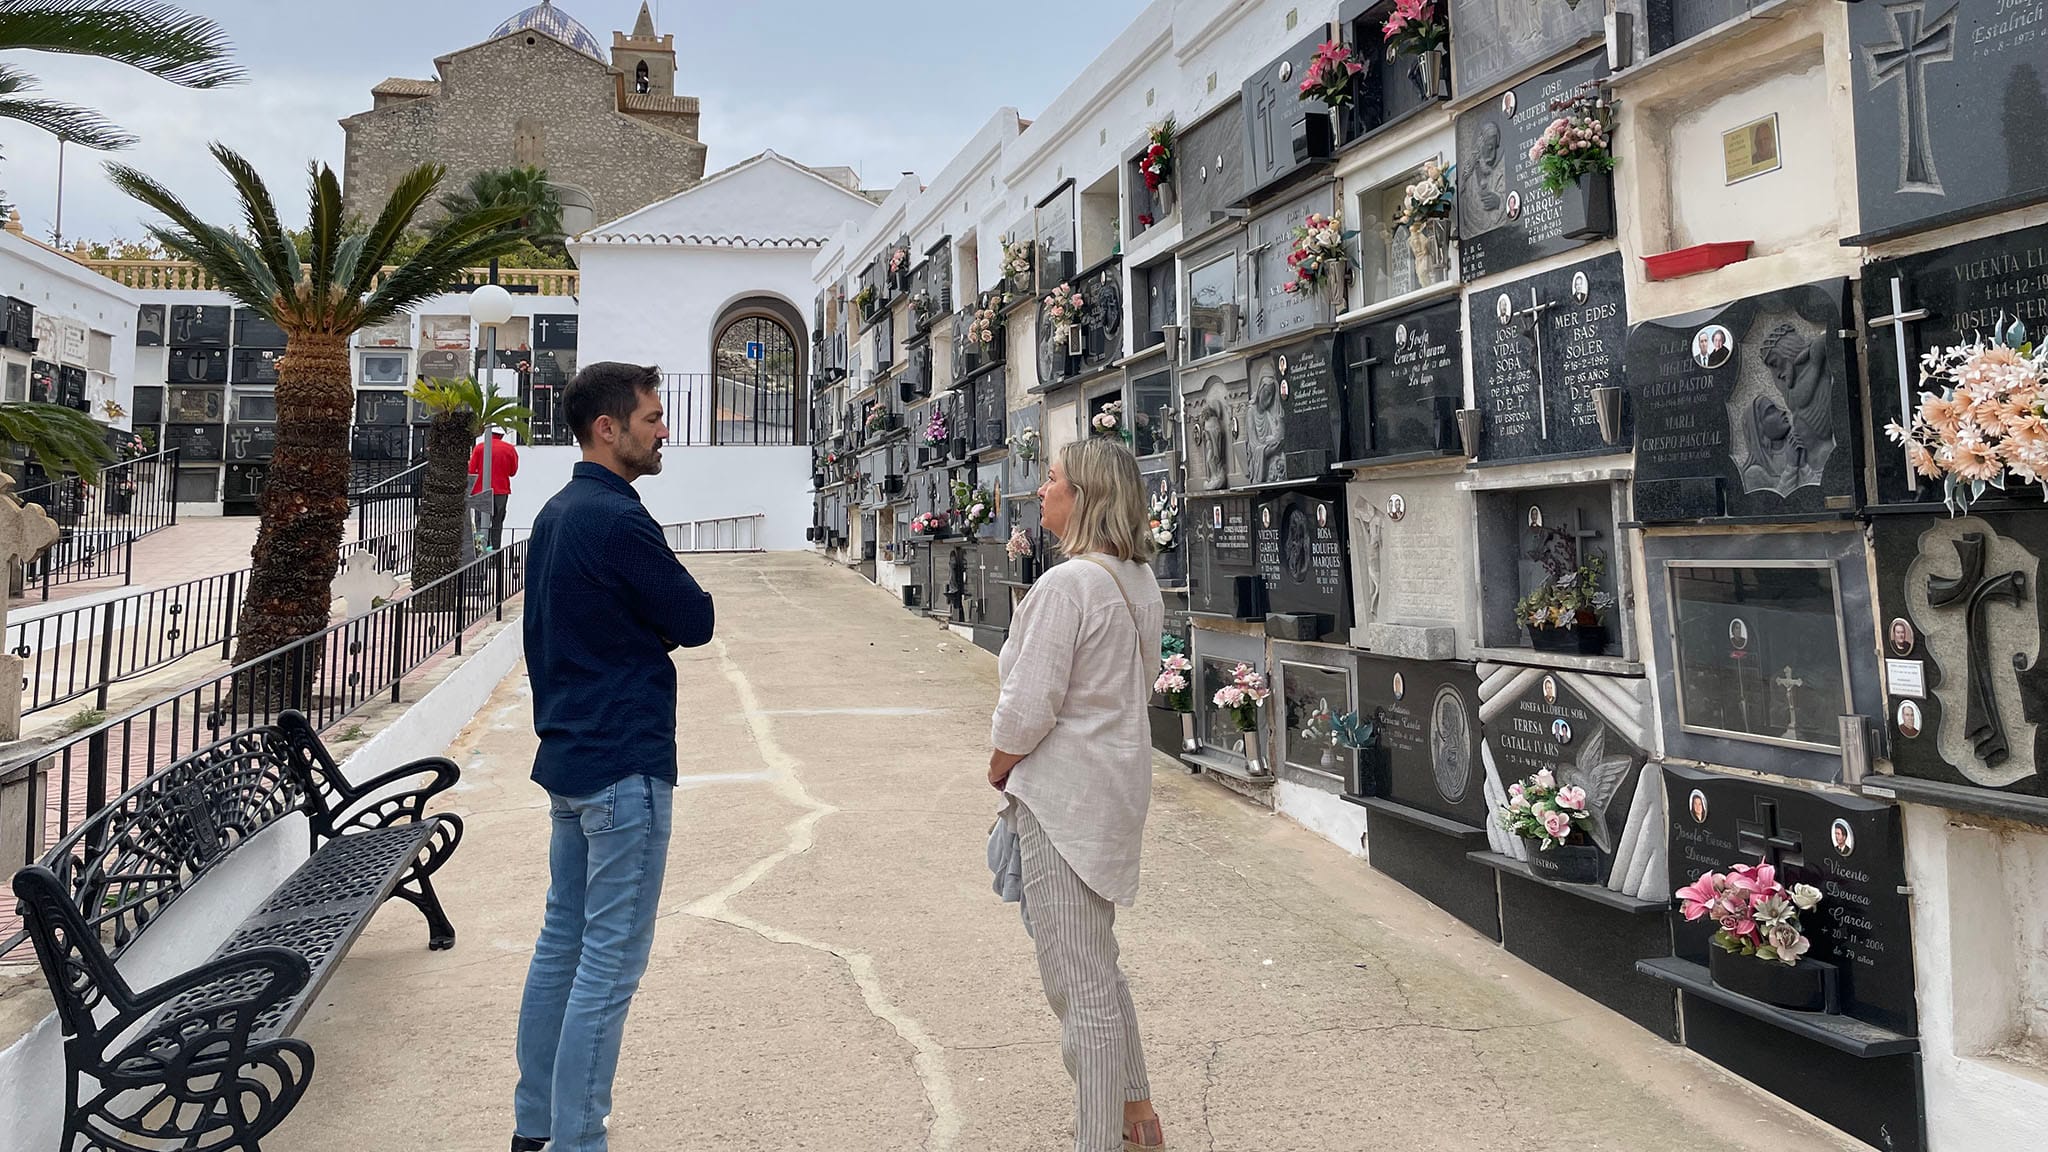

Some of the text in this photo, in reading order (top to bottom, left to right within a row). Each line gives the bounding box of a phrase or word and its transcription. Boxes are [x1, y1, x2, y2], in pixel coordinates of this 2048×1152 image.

[1972, 2, 2043, 44] Estalrich
[1541, 79, 1562, 98] JOSE
[1512, 101, 1546, 126] BOLUFER
[1522, 196, 1563, 217] MARQUE
[1954, 247, 2048, 281] VICENTA LL
[1952, 306, 2008, 332] JOSEFA
[1495, 325, 1519, 344] JOSE
[1573, 324, 1596, 342] BAS
[1493, 341, 1522, 358] VIDAL
[1566, 339, 1603, 359] SOLER
[1496, 356, 1522, 373] SOBA
[1564, 375, 1575, 386] DE
[1642, 374, 1714, 398] GARCIA PASTOR
[1505, 411, 1531, 423] ESPOSA
[1570, 414, 1597, 427] Y NIET
[1664, 414, 1695, 431] MARIA
[1642, 430, 1722, 452] CRESPO PASCUAL
[1258, 529, 1280, 540] VICENTE
[1317, 527, 1332, 539] ROSA
[1260, 542, 1280, 553] GARCIA
[1312, 542, 1339, 554] BOLUFER
[1260, 553, 1281, 564] CATALA
[1312, 556, 1341, 569] MARQUES
[1519, 700, 1541, 713] JOSEFA
[1570, 708, 1588, 721] SOBA
[1513, 717, 1544, 736] TERESA
[1501, 734, 1532, 752] CATALA
[1673, 822, 1733, 850] Josefa Teresa
[1684, 845, 1721, 866] Devesa
[1823, 857, 1870, 883] Vicente
[1825, 880, 1871, 906] Devesa
[1828, 906, 1873, 931] Garcia
[1833, 945, 1843, 955] de
